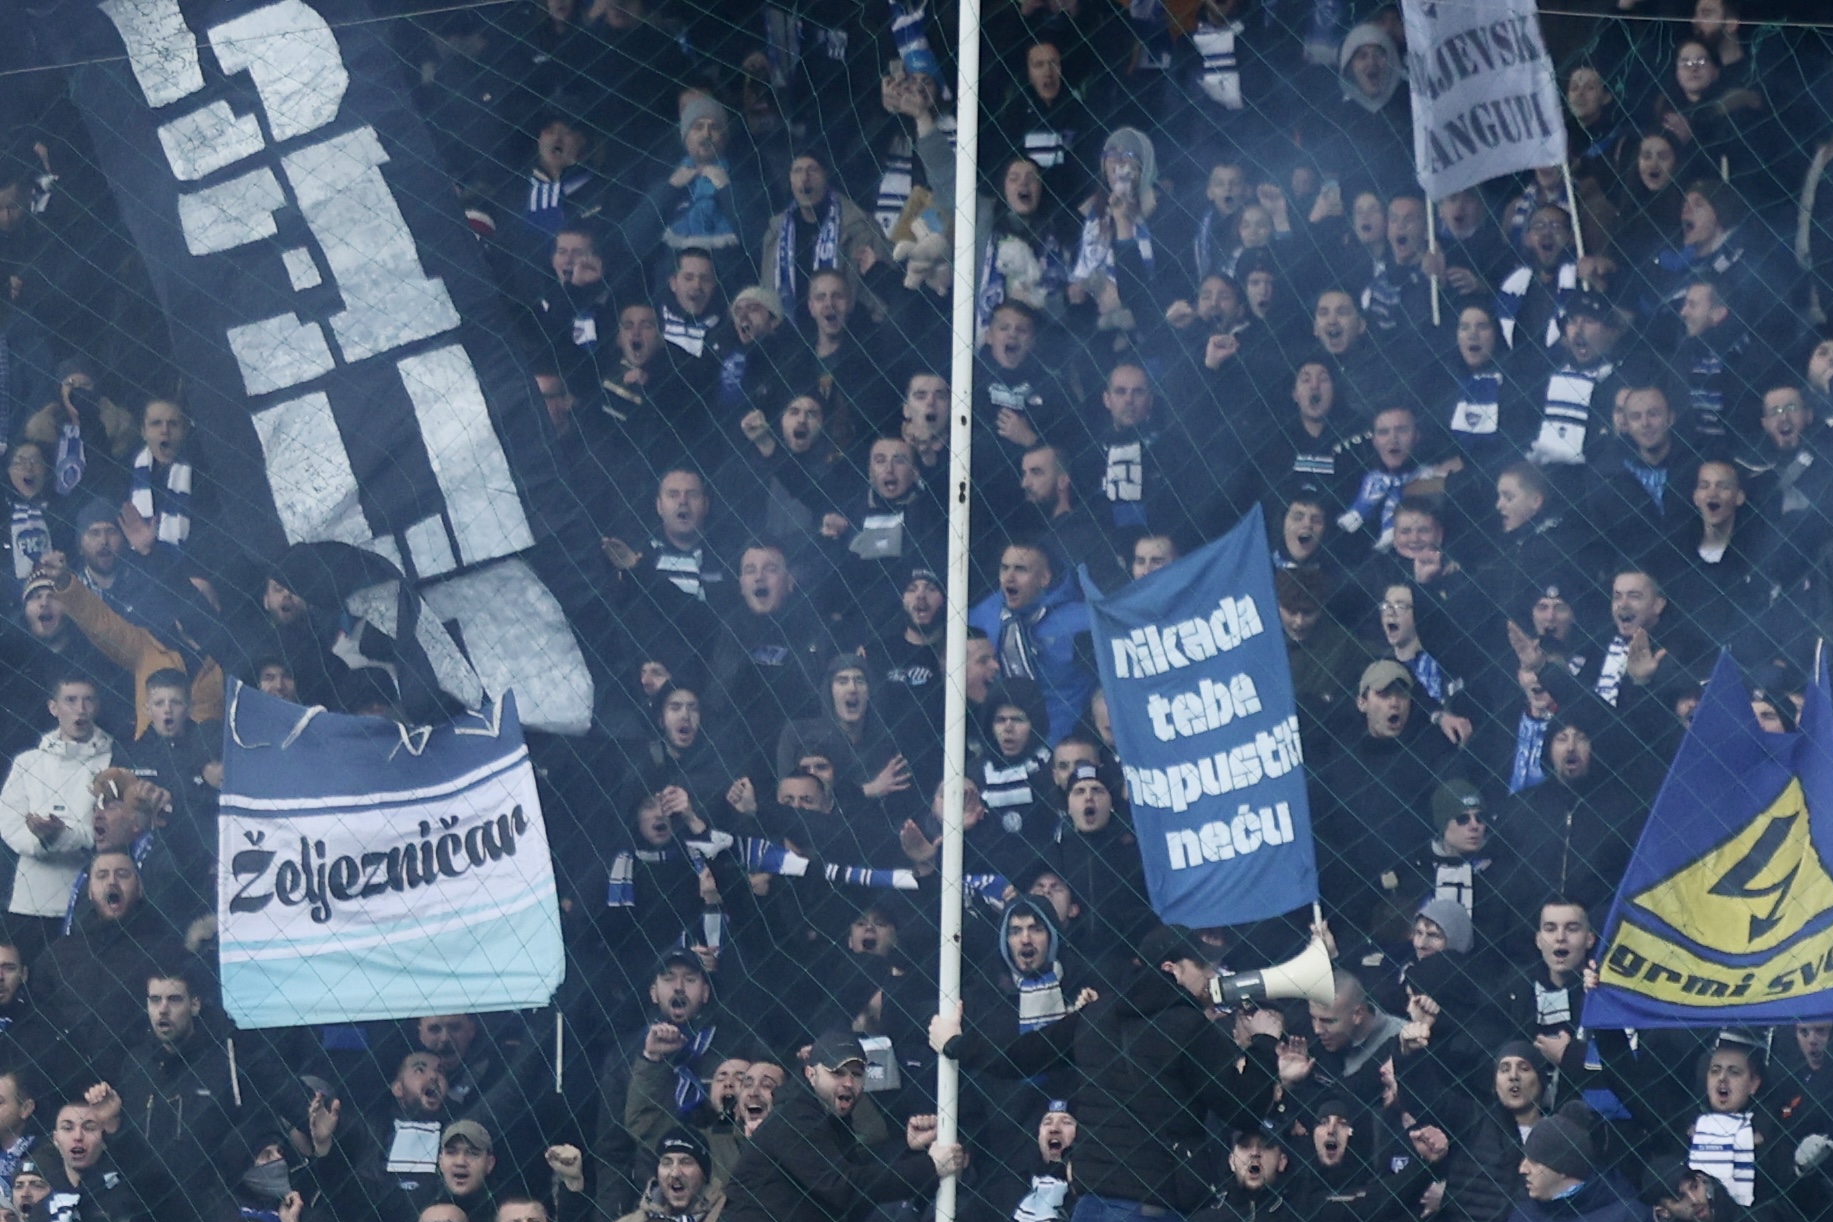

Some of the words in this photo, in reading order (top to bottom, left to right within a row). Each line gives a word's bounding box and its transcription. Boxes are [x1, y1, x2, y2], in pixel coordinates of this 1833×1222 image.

[1111, 594, 1265, 679] nikada
[1146, 672, 1263, 742] tebe
[229, 804, 530, 924] Željezničar
[1165, 801, 1295, 871] neću
[1607, 944, 1756, 998] grmi
